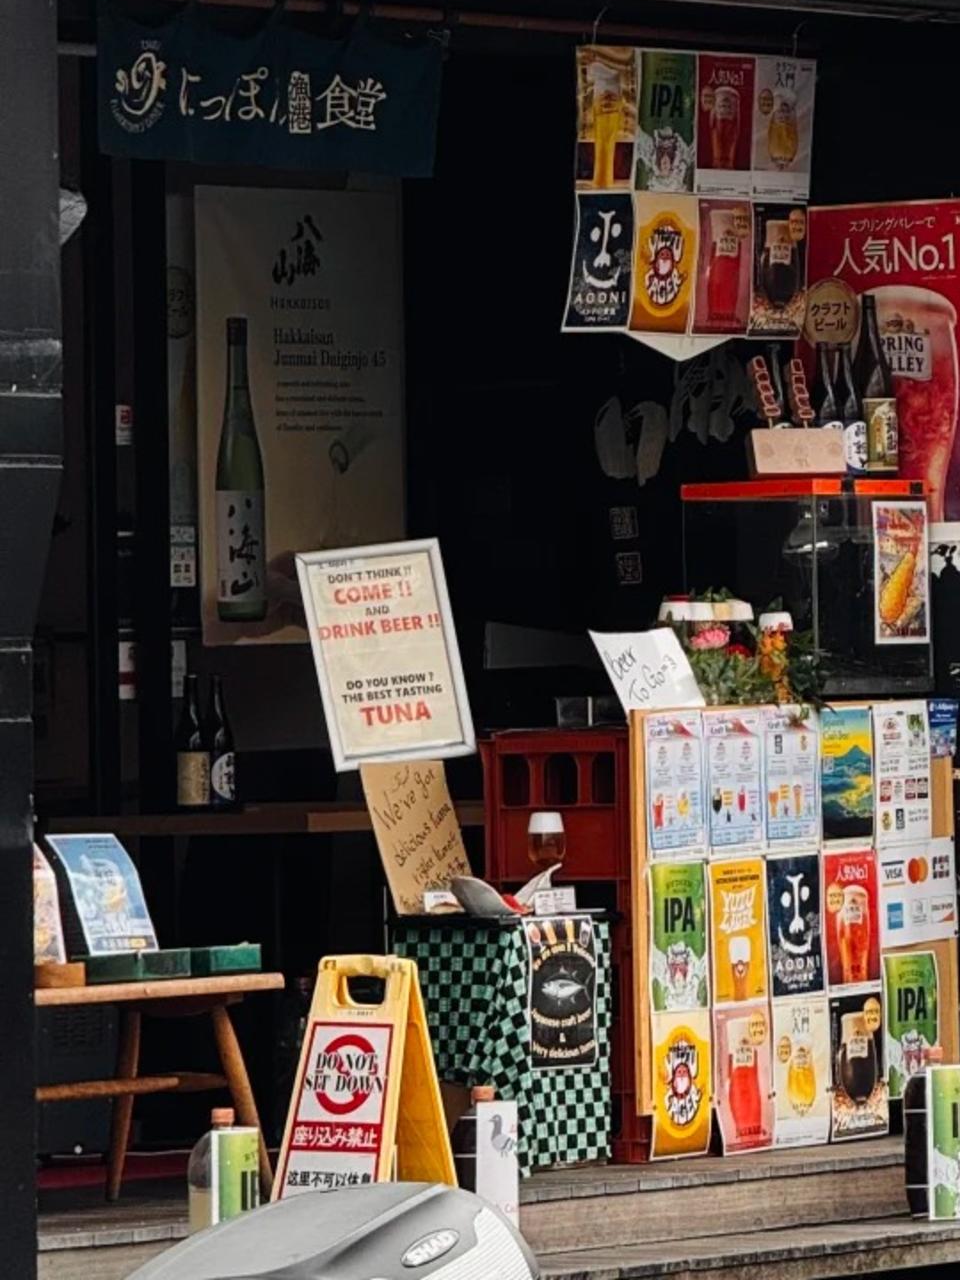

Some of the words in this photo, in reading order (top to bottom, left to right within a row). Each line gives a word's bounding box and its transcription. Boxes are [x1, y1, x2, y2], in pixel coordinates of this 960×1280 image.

[650, 83, 685, 119] IPA
[832, 232, 956, 277] 人気No.1
[810, 301, 850, 317] クラフト
[273, 327, 335, 346] Hakkaisan
[328, 570, 362, 584] DON'T
[364, 567, 401, 580] THINK
[333, 583, 393, 605] COME
[365, 605, 390, 617] AND
[319, 620, 377, 641] DRINK
[380, 615, 424, 634] BEER
[346, 679, 363, 691] DO
[365, 677, 389, 690] YOU
[391, 673, 426, 687] KNOW
[342, 691, 364, 704] THE
[366, 688, 393, 702] BEST
[395, 684, 443, 699] TASTING
[359, 701, 432, 727] TUNA
[885, 866, 904, 879] VISA
[664, 896, 696, 933] IPA
[897, 986, 927, 1022] IPA
[315, 1053, 338, 1070] DO
[343, 1053, 379, 1071] NOT
[305, 1074, 331, 1091] SIT
[335, 1075, 386, 1093] DOWN
[292, 1125, 378, 1148] 座り込み禁止
